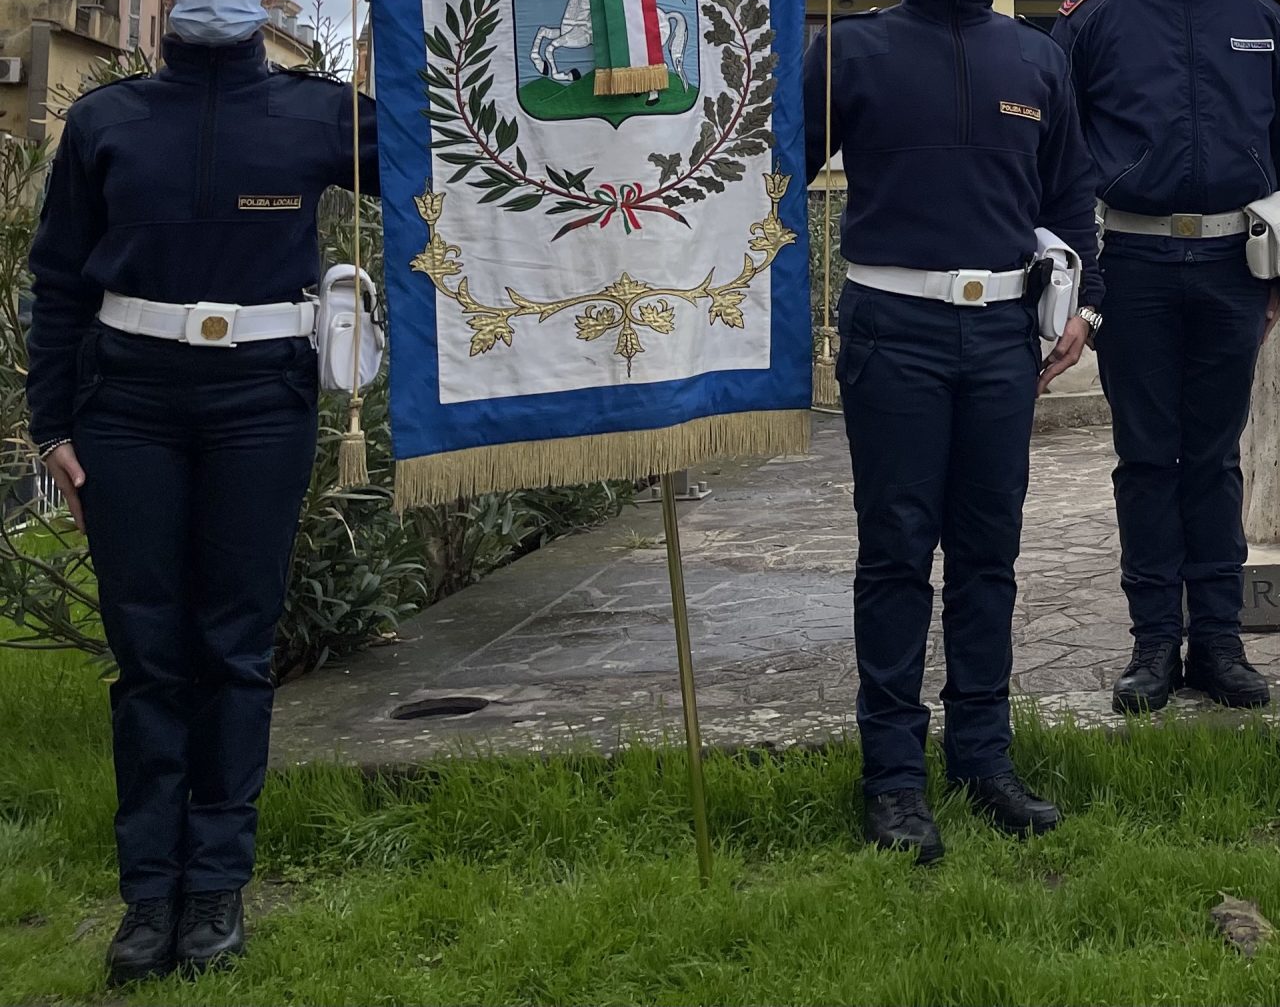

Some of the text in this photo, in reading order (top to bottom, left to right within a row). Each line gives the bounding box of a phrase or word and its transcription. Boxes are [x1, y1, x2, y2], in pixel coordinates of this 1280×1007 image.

[1001, 104, 1022, 114] POLIZIA
[240, 198, 299, 207] POLIZIA LOCALE
